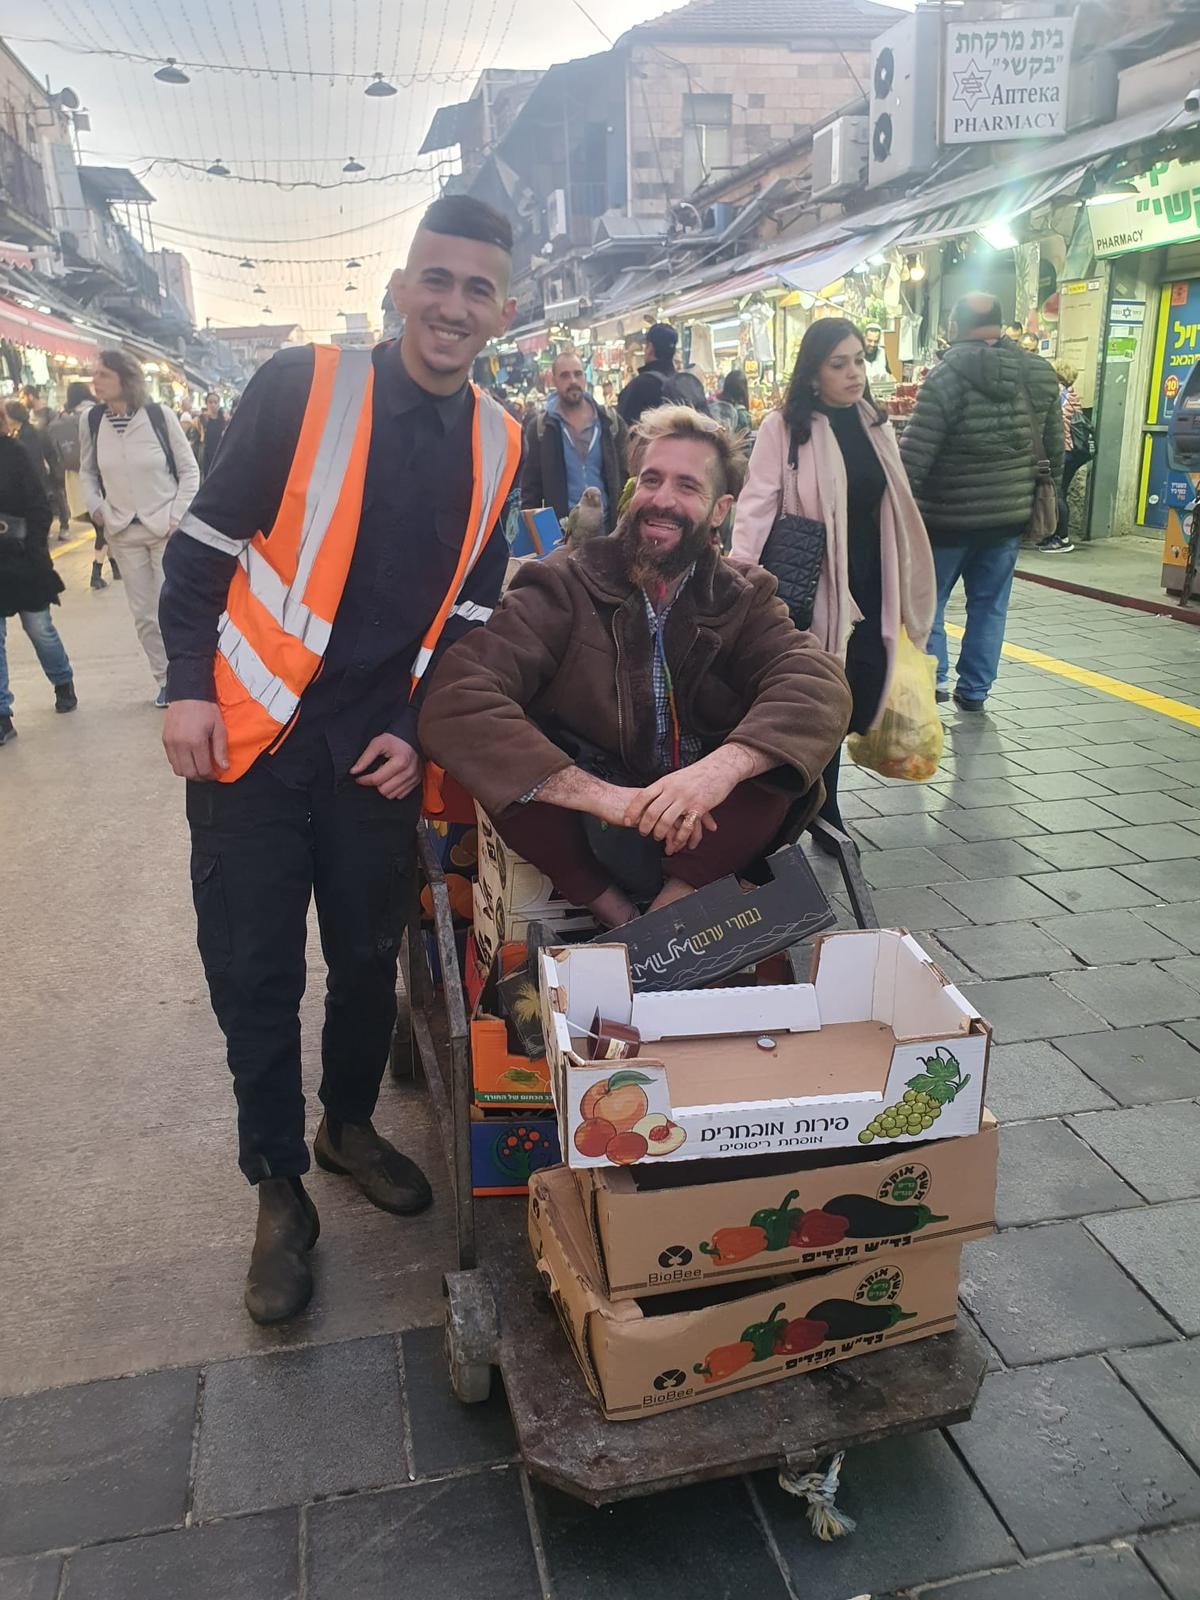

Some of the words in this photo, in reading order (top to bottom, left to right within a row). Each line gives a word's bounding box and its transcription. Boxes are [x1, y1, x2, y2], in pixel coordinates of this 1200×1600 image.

[955, 30, 1025, 59] מרקחת
[1030, 28, 1064, 50] בית
[992, 54, 1064, 80] "בקשי"
[991, 83, 1060, 105] Аптека
[954, 112, 1060, 133] PHARMACY
[725, 907, 762, 931] נבחרי
[691, 924, 724, 951] ערבה
[701, 1121, 785, 1142] מובחרים
[794, 1116, 850, 1134] פירות
[778, 1136, 823, 1147] מופחת
[648, 1269, 702, 1284] BioBee
[642, 1388, 694, 1405] BioBee
